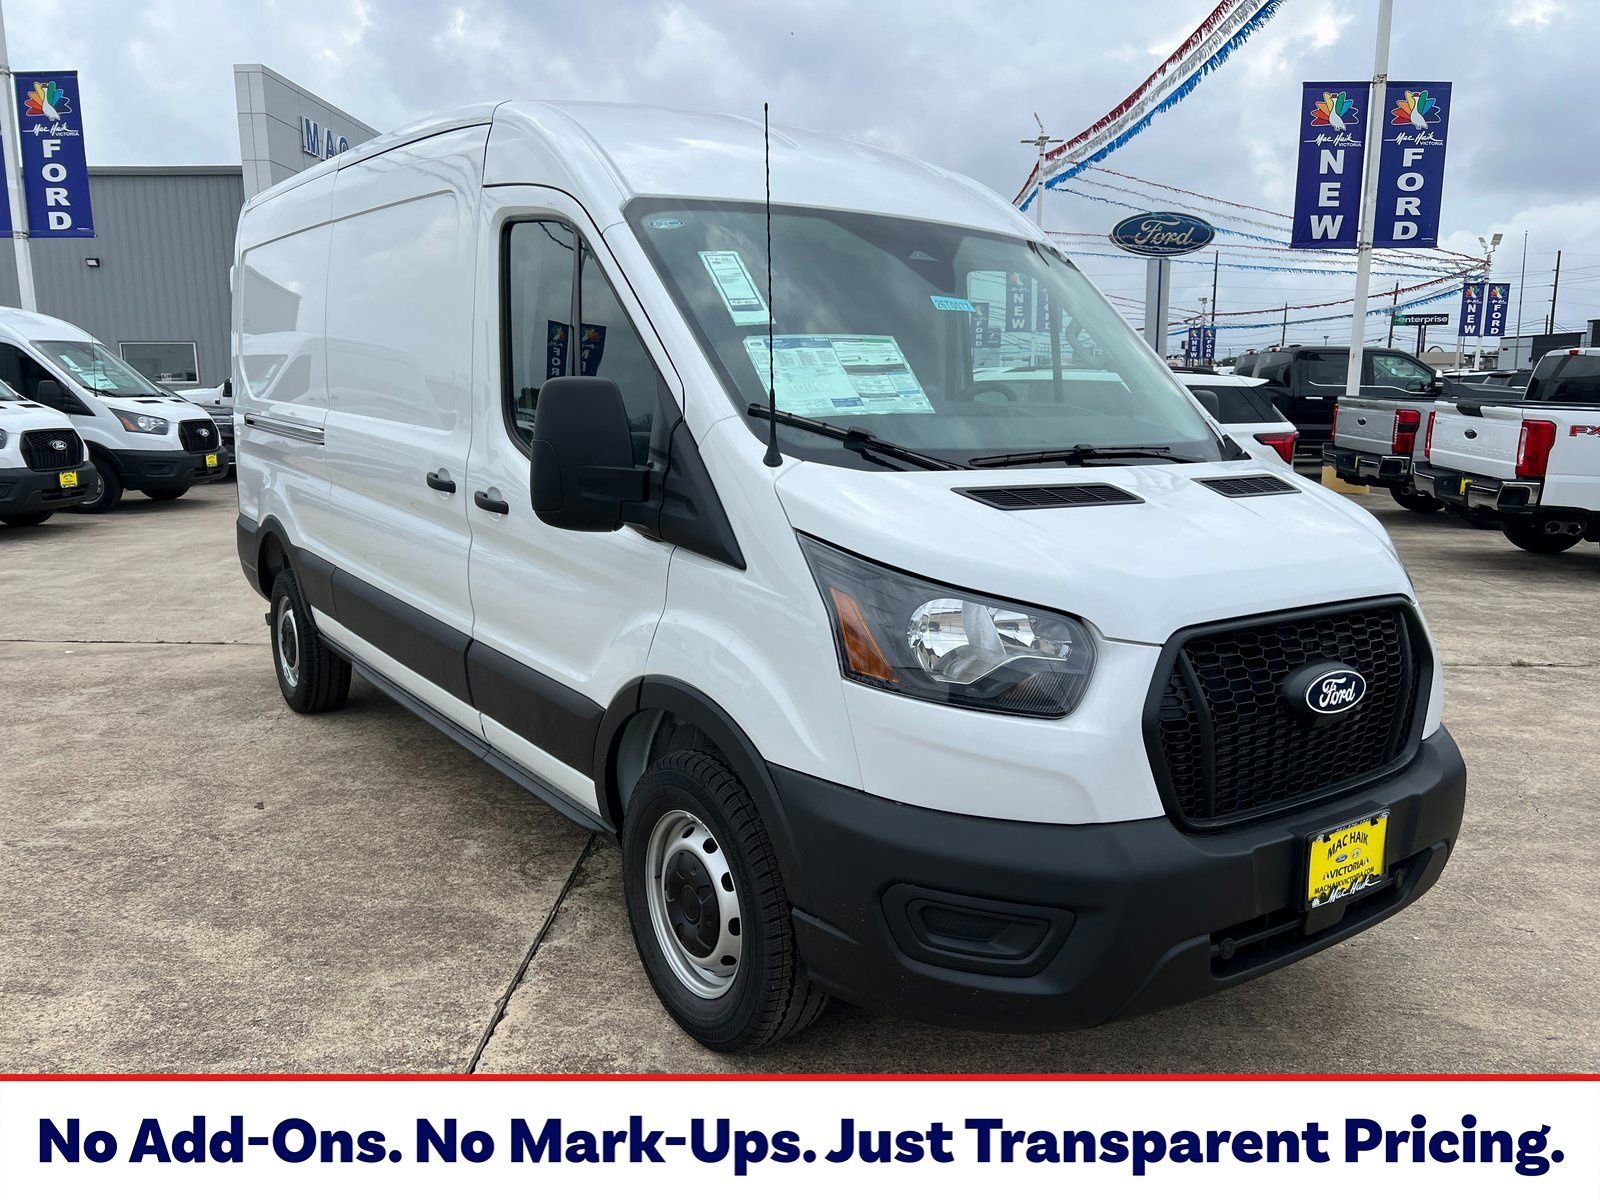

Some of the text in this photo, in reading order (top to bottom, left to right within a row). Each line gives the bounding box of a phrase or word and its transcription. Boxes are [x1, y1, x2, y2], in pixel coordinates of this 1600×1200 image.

[41, 139, 72, 230] FORD
[1310, 149, 1345, 240] NEW
[1392, 148, 1425, 240] FORD
[1134, 219, 1196, 246] Ford
[1011, 293, 1025, 329] NEW
[1399, 315, 1448, 325] enterprise
[1464, 304, 1476, 334] NEW
[1490, 304, 1502, 334] FORD
[975, 320, 983, 347] FORD
[1190, 340, 1198, 358] NEW
[1319, 677, 1356, 708] Ford
[1327, 831, 1368, 860] MAC HAIK
[1330, 859, 1363, 879] VICTORIA
